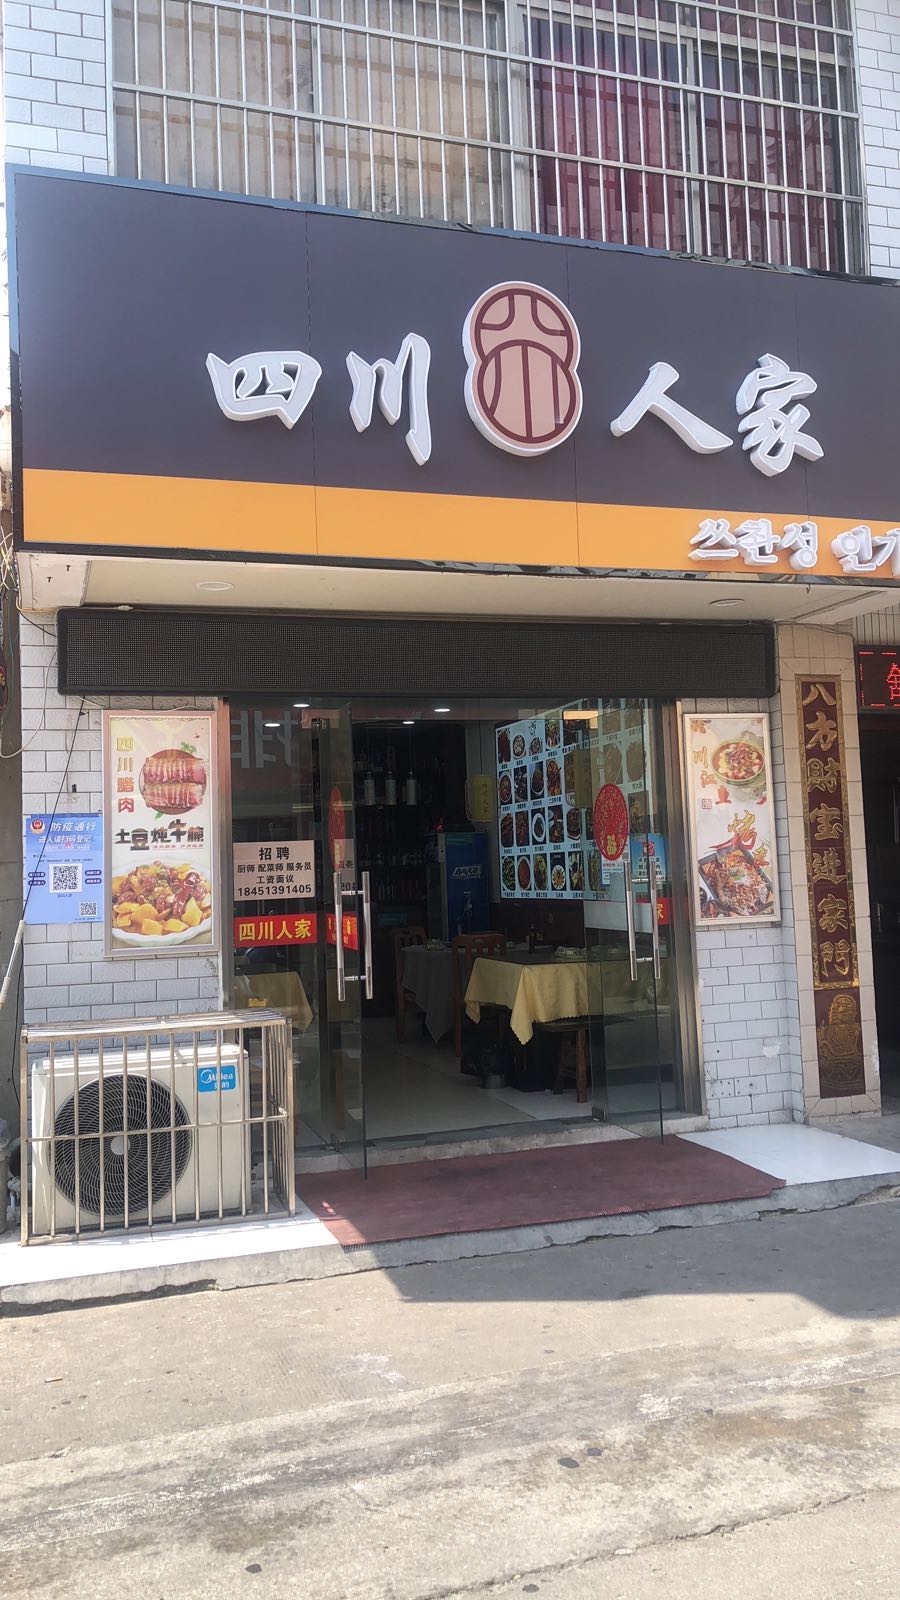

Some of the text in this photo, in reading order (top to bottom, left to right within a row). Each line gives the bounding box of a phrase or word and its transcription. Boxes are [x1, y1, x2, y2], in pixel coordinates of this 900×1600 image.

[205, 332, 824, 477] 四川 人家
[688, 517, 818, 571] 쓰촨성
[50, 821, 97, 832] 防疫通行
[258, 846, 290, 861] 招聘
[237, 861, 312, 874] 厨师 配菜师 服务员
[256, 874, 295, 885] 工资面议
[237, 884, 312, 897] 18451391405
[239, 918, 312, 942] 四川人家
[200, 1069, 233, 1084] Mea
[213, 1080, 230, 1089] 的
